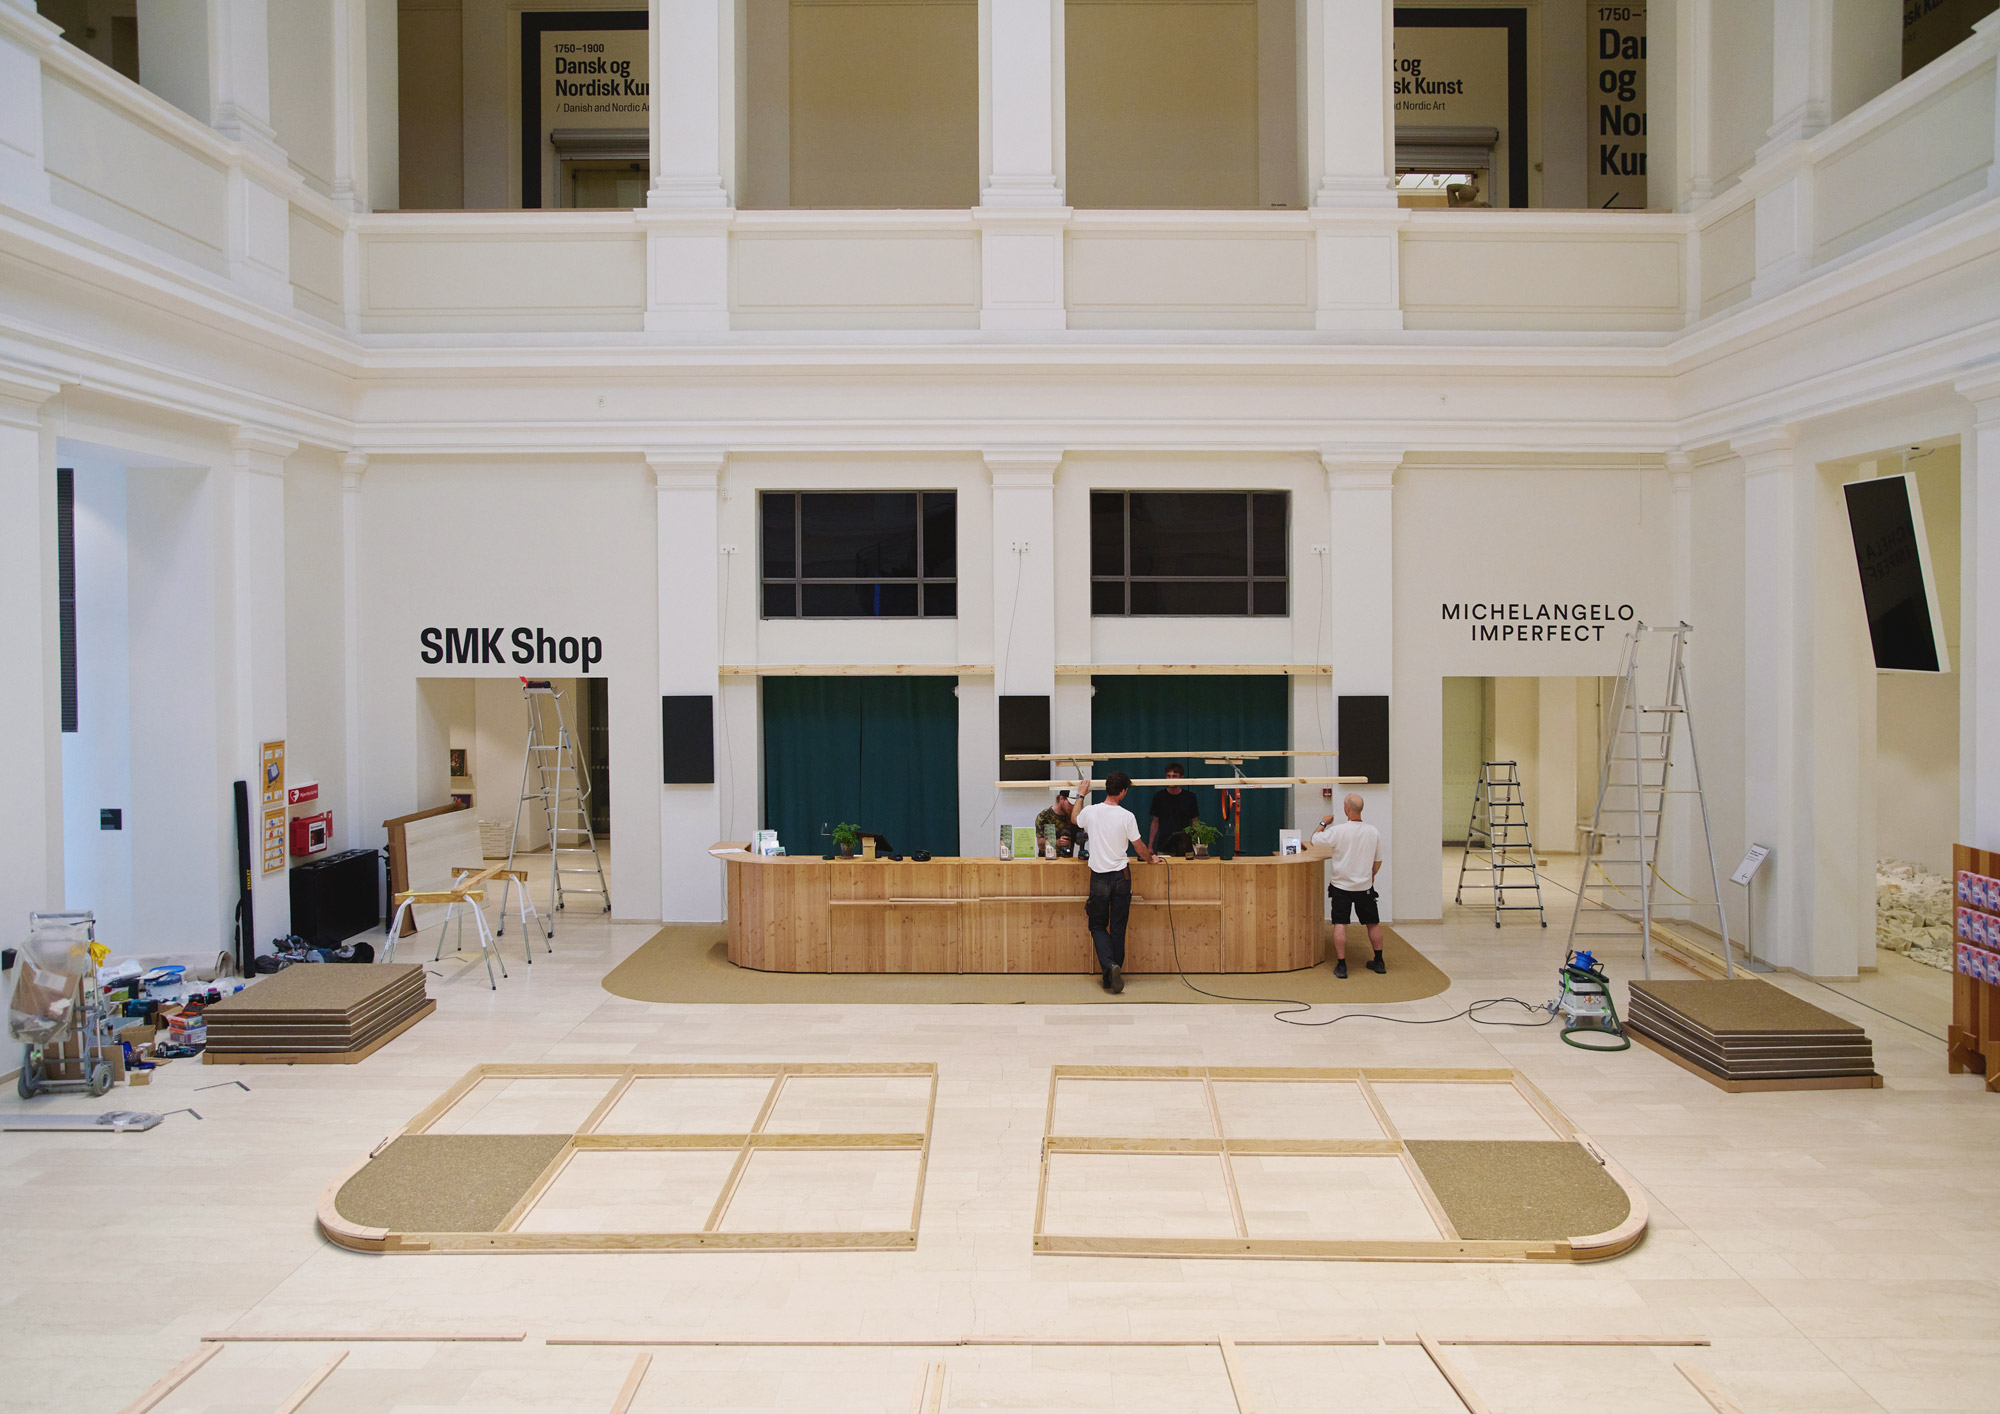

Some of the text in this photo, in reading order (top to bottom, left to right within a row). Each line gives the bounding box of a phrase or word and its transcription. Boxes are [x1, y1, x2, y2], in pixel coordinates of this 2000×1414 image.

[554, 43, 604, 53] 1750–1900
[555, 57, 630, 78] Dansk og
[1401, 59, 1421, 77] og
[555, 79, 620, 96] Nordisk
[1415, 77, 1463, 95] Kunst
[1600, 69, 1636, 101] og
[563, 103, 593, 112] Danish
[594, 102, 611, 112] and
[612, 102, 640, 112] Nordic
[1403, 101, 1431, 111] Nordic
[1433, 101, 1446, 111] Art
[1442, 603, 1634, 621] MICHELANGELO
[1472, 625, 1605, 641] IMPERFECT
[420, 627, 602, 673] SMK Shop
